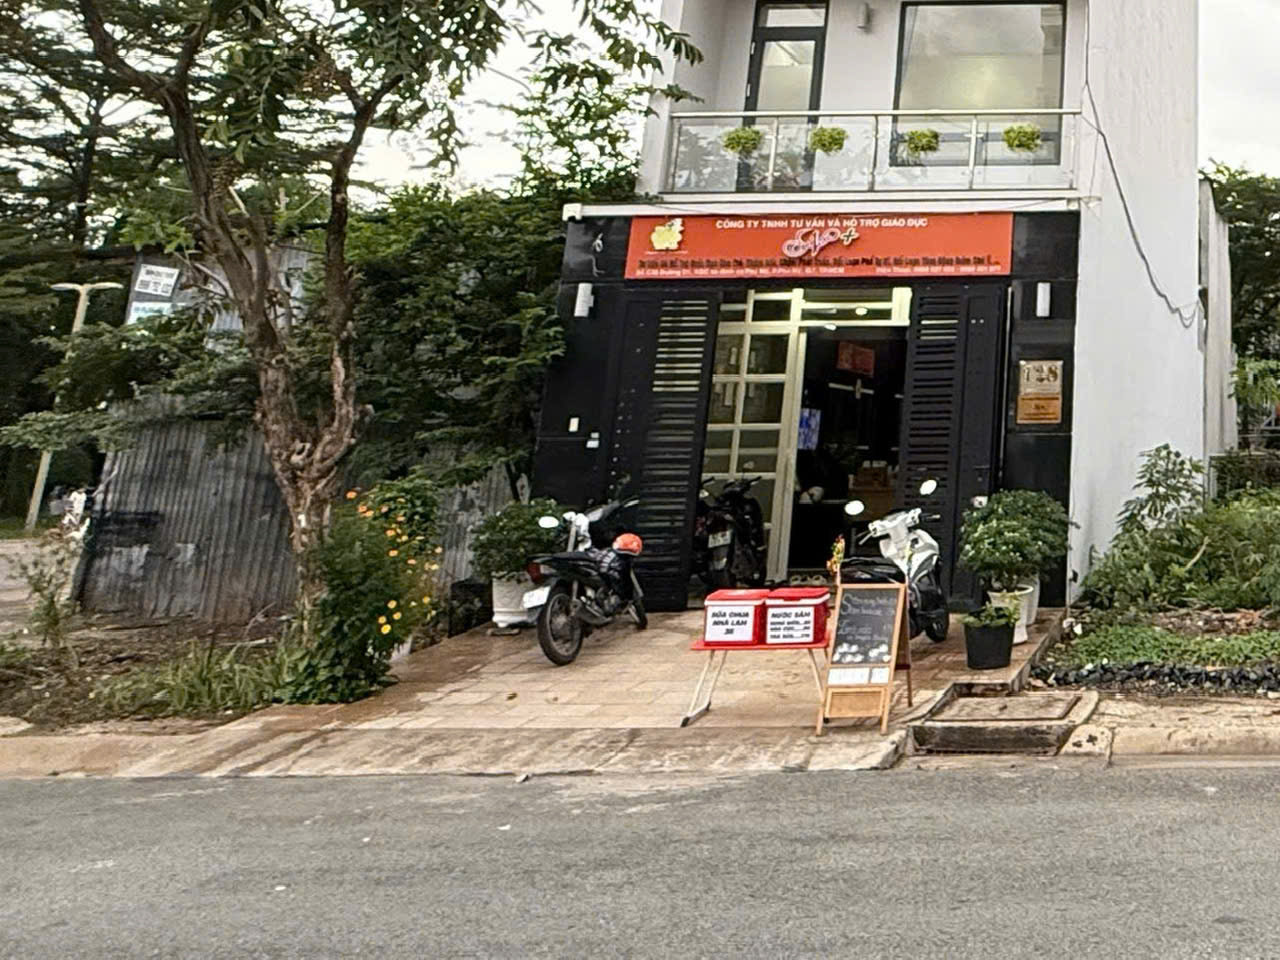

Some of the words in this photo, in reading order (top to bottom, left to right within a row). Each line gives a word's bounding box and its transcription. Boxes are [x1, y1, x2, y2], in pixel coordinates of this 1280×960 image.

[716, 218, 744, 228] CÔNG
[746, 219, 759, 228] TY
[761, 219, 788, 228] TNHH
